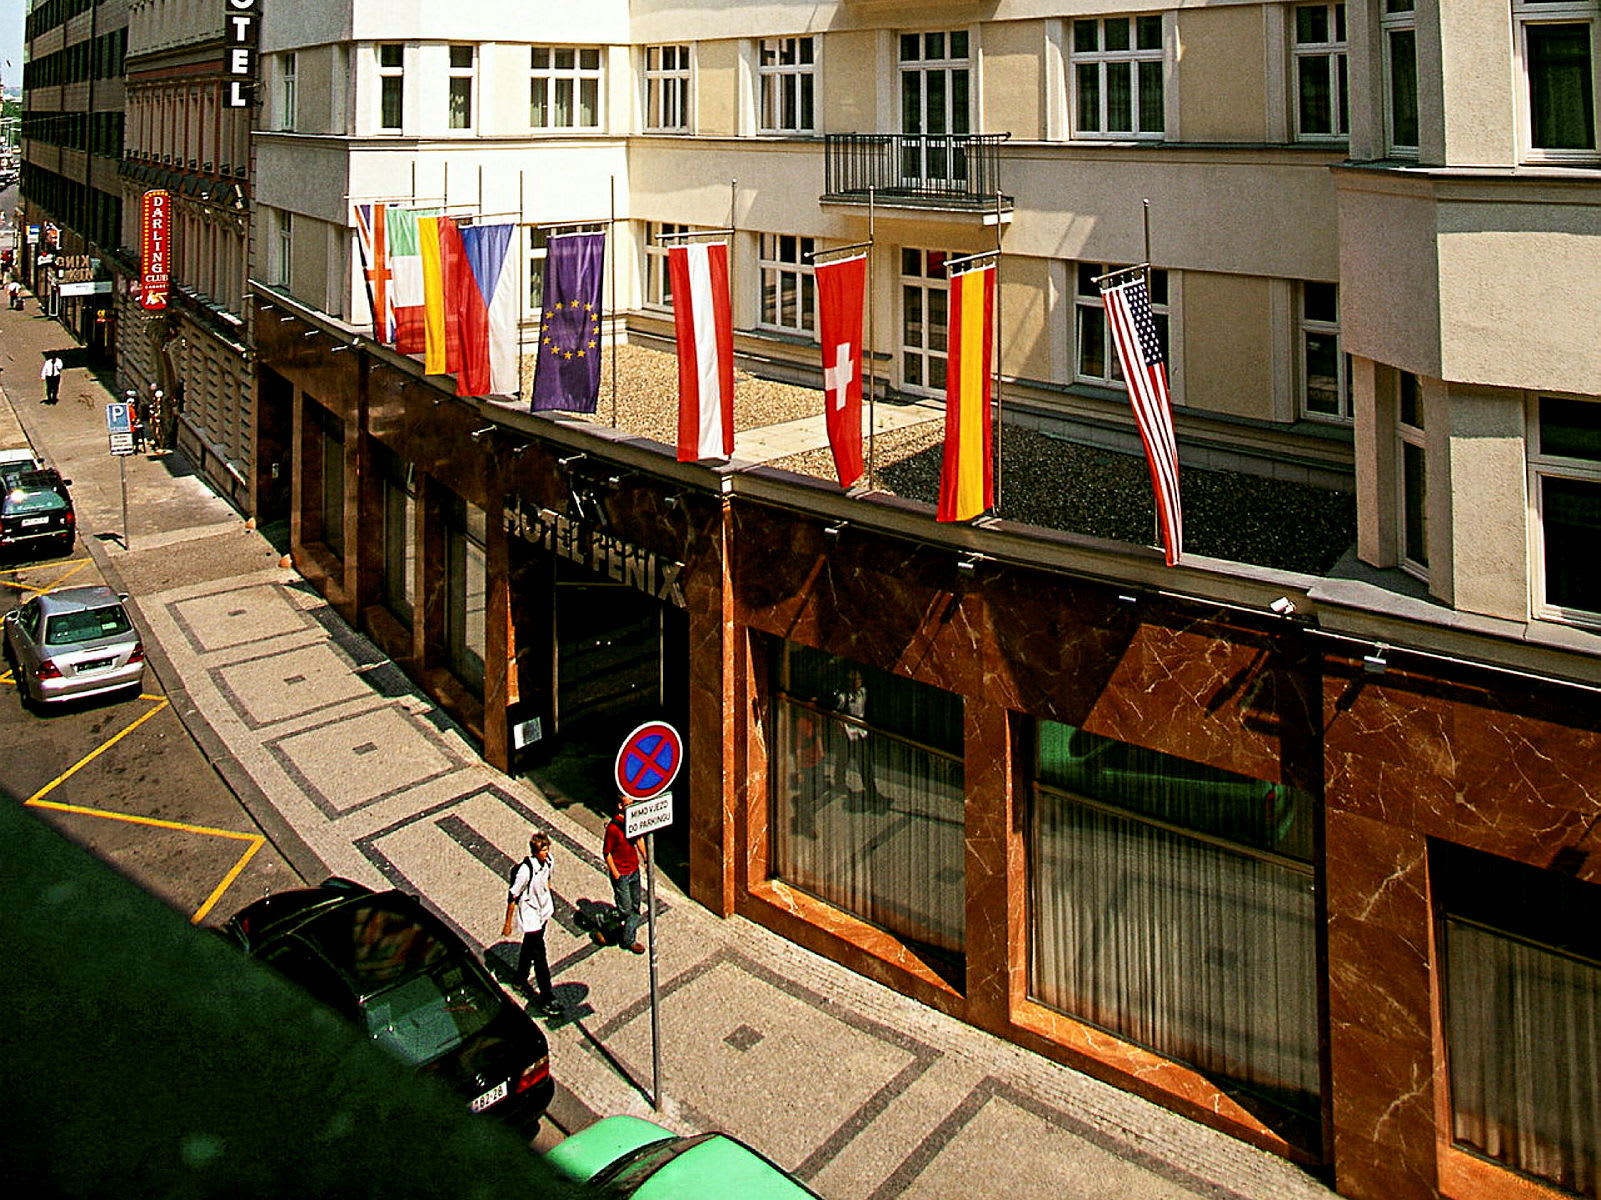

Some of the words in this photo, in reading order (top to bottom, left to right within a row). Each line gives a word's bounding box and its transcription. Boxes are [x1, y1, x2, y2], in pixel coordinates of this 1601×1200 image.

[151, 196, 164, 273] DARLING
[145, 274, 169, 283] CLUB
[112, 405, 124, 423] P
[503, 493, 585, 566] HOTEL
[592, 530, 687, 608] FENIX
[628, 823, 638, 833] DO
[639, 812, 671, 829] PARKINGU
